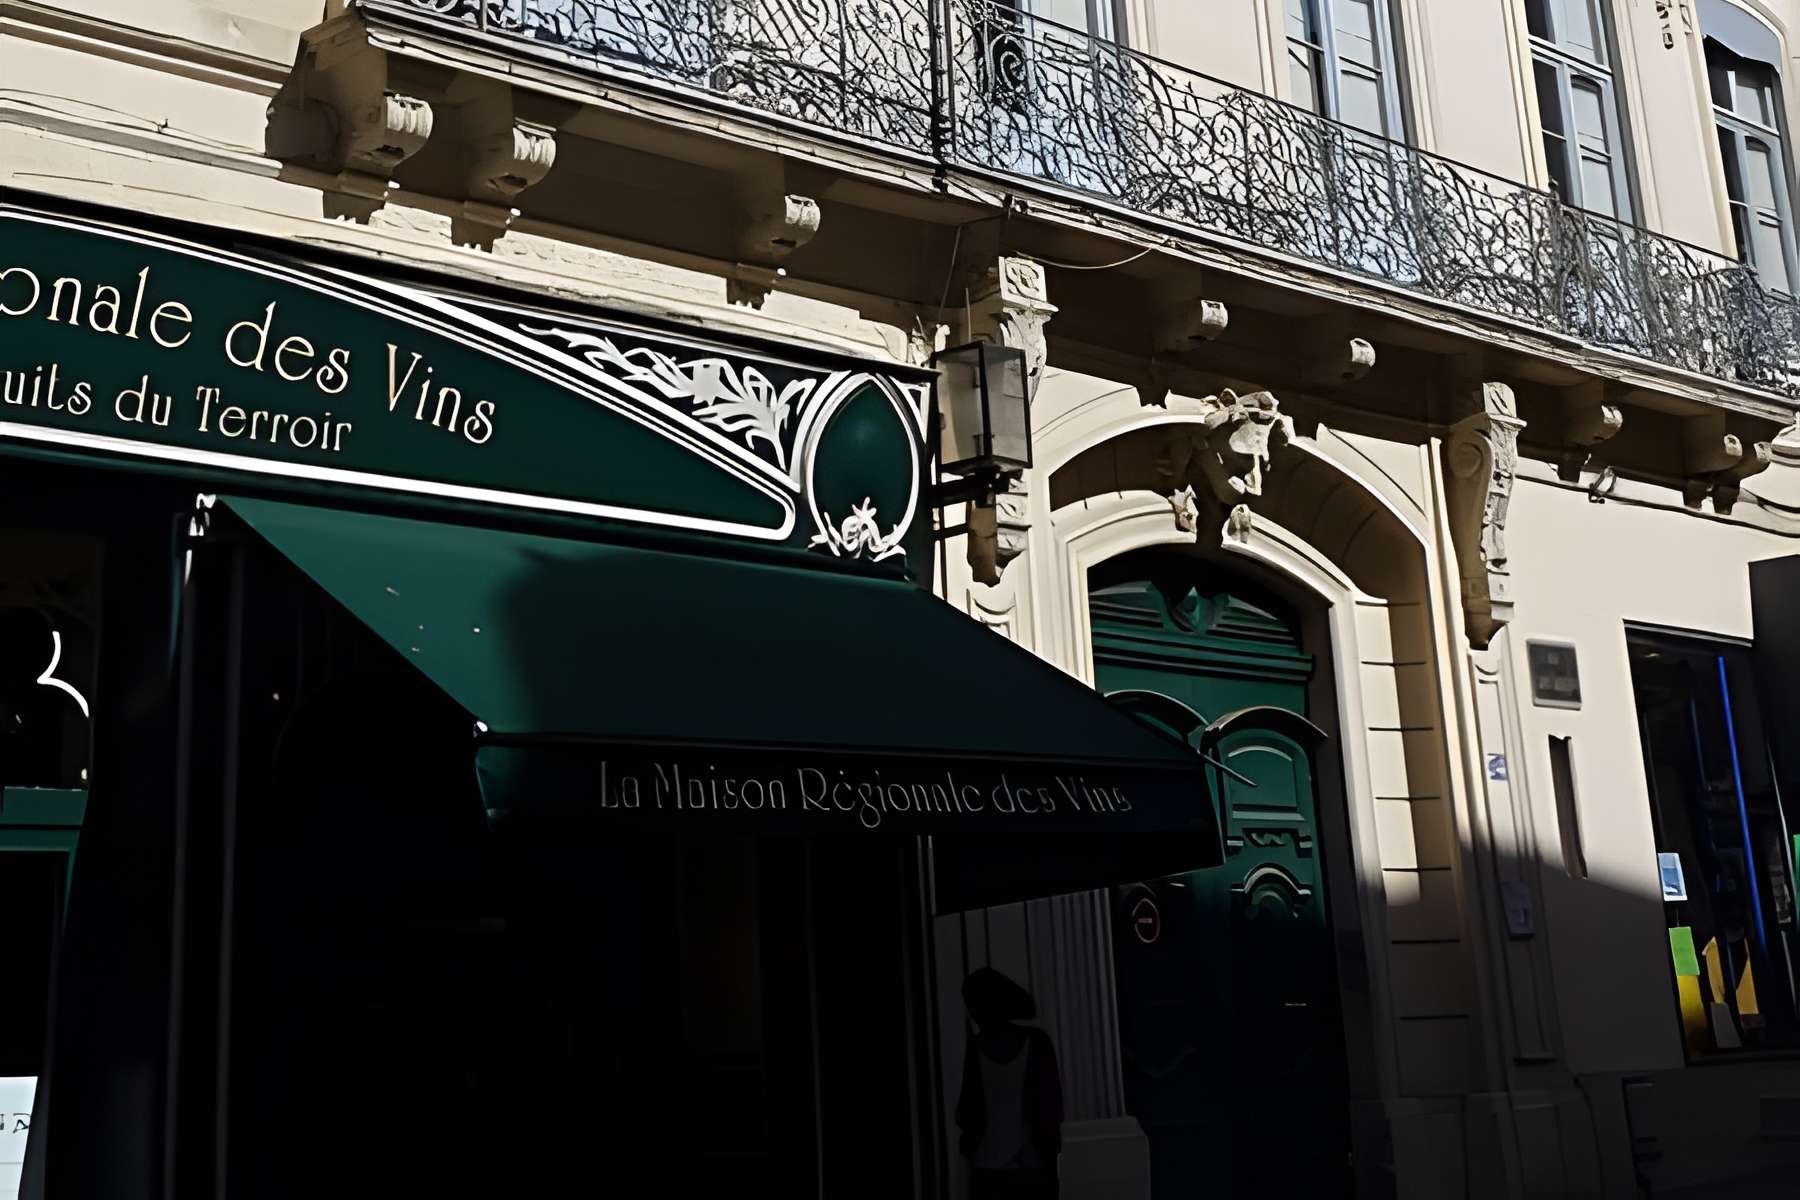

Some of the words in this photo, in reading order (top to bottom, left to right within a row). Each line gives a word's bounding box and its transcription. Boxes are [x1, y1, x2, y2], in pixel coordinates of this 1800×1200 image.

[0, 363, 92, 415] uits
[115, 374, 172, 426] du
[196, 385, 352, 452] Terroir
[225, 301, 351, 394] des
[386, 343, 496, 445] Vins
[601, 760, 640, 808] La
[652, 761, 786, 809] Maison
[795, 767, 984, 829] Régionale
[992, 771, 1056, 814] des
[1055, 774, 1133, 813] Vins
